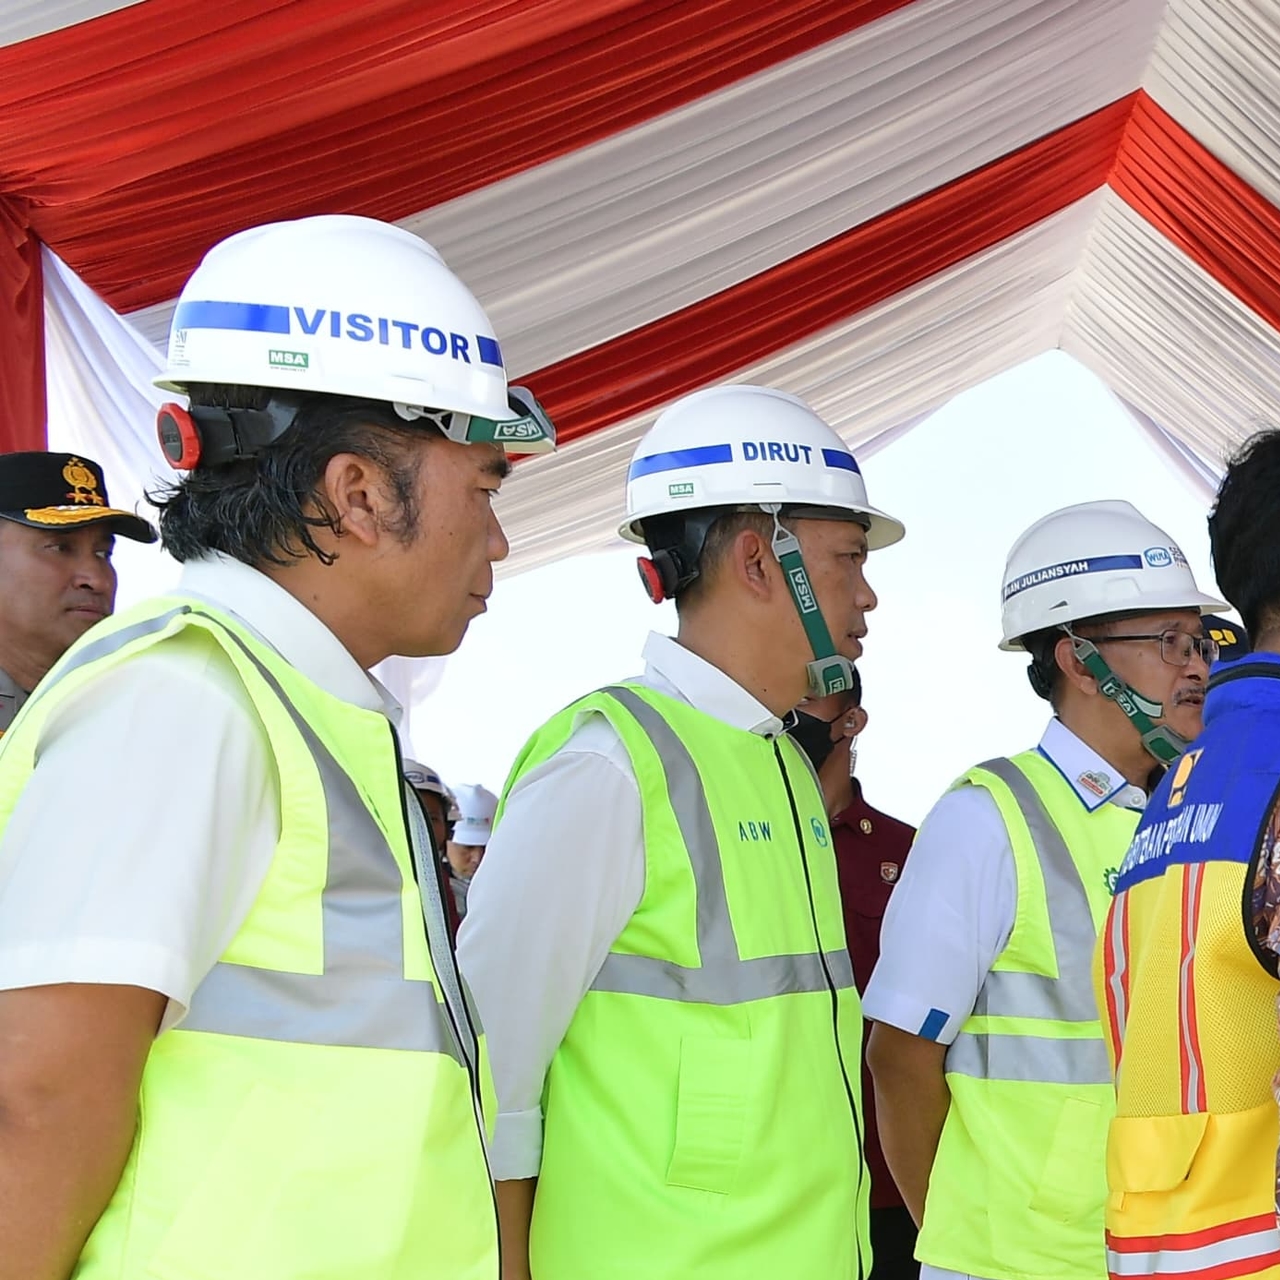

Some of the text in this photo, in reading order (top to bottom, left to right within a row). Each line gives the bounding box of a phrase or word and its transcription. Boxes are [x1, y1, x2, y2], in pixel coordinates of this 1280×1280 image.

[294, 306, 470, 363] VISITOR
[270, 352, 306, 366] MSA
[742, 442, 812, 464] DIRUT
[670, 485, 693, 494] MSA
[1021, 562, 1088, 587] JULIANSYAH
